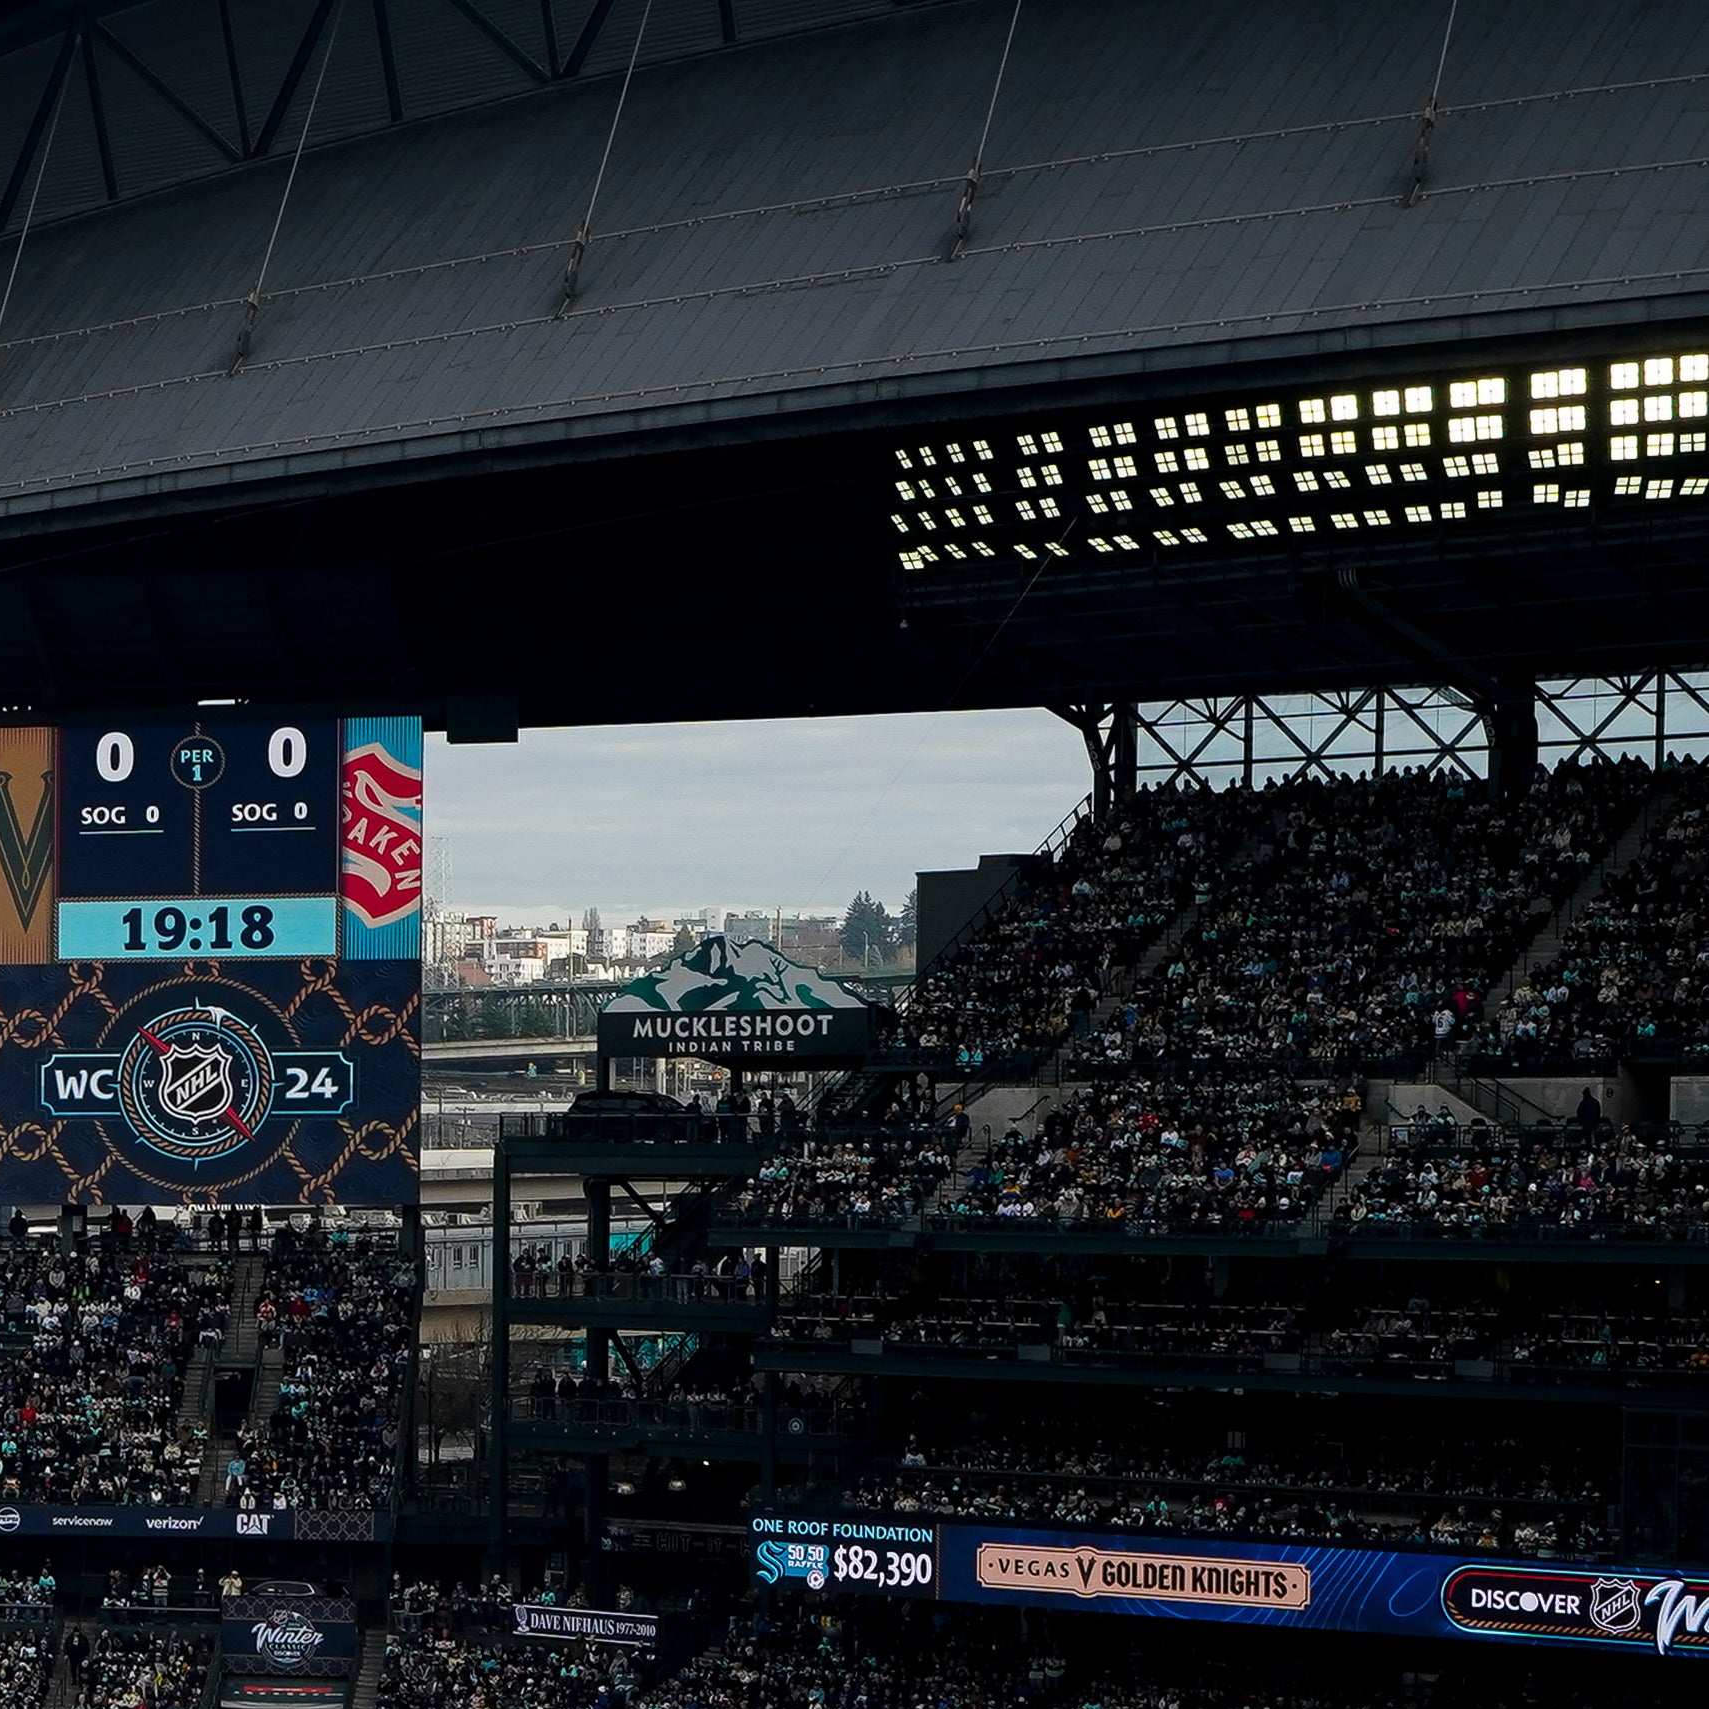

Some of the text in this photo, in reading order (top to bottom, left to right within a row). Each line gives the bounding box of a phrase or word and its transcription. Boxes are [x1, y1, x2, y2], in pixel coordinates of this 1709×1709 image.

[96, 731, 135, 783] 0
[180, 749, 214, 763] PER
[268, 727, 307, 778] 0
[192, 765, 203, 782] 1
[81, 805, 161, 825] SOG 0
[232, 802, 308, 822] SOG 0
[122, 905, 275, 951] 19:18
[633, 1014, 834, 1038] MUCKLESHOOT
[669, 1040, 795, 1053] INDIAN TRIBE
[54, 1069, 115, 1100] WC
[175, 1061, 220, 1107] NHL
[285, 1068, 338, 1098] 24
[52, 1517, 113, 1527] servicenow
[146, 1517, 196, 1531] verizon
[236, 1514, 270, 1536] CAT
[752, 1518, 933, 1543] ONE ROOF FOUNDATION
[834, 1545, 932, 1588] $82,390
[998, 1557, 1288, 1599] VEGAS GOLDEN KNIGHTS
[1471, 1588, 1630, 1621] DISCOVER NHL
[251, 1622, 324, 1653] Winter
[531, 1613, 656, 1637] DAVE NIEHAUS 1977-2010
